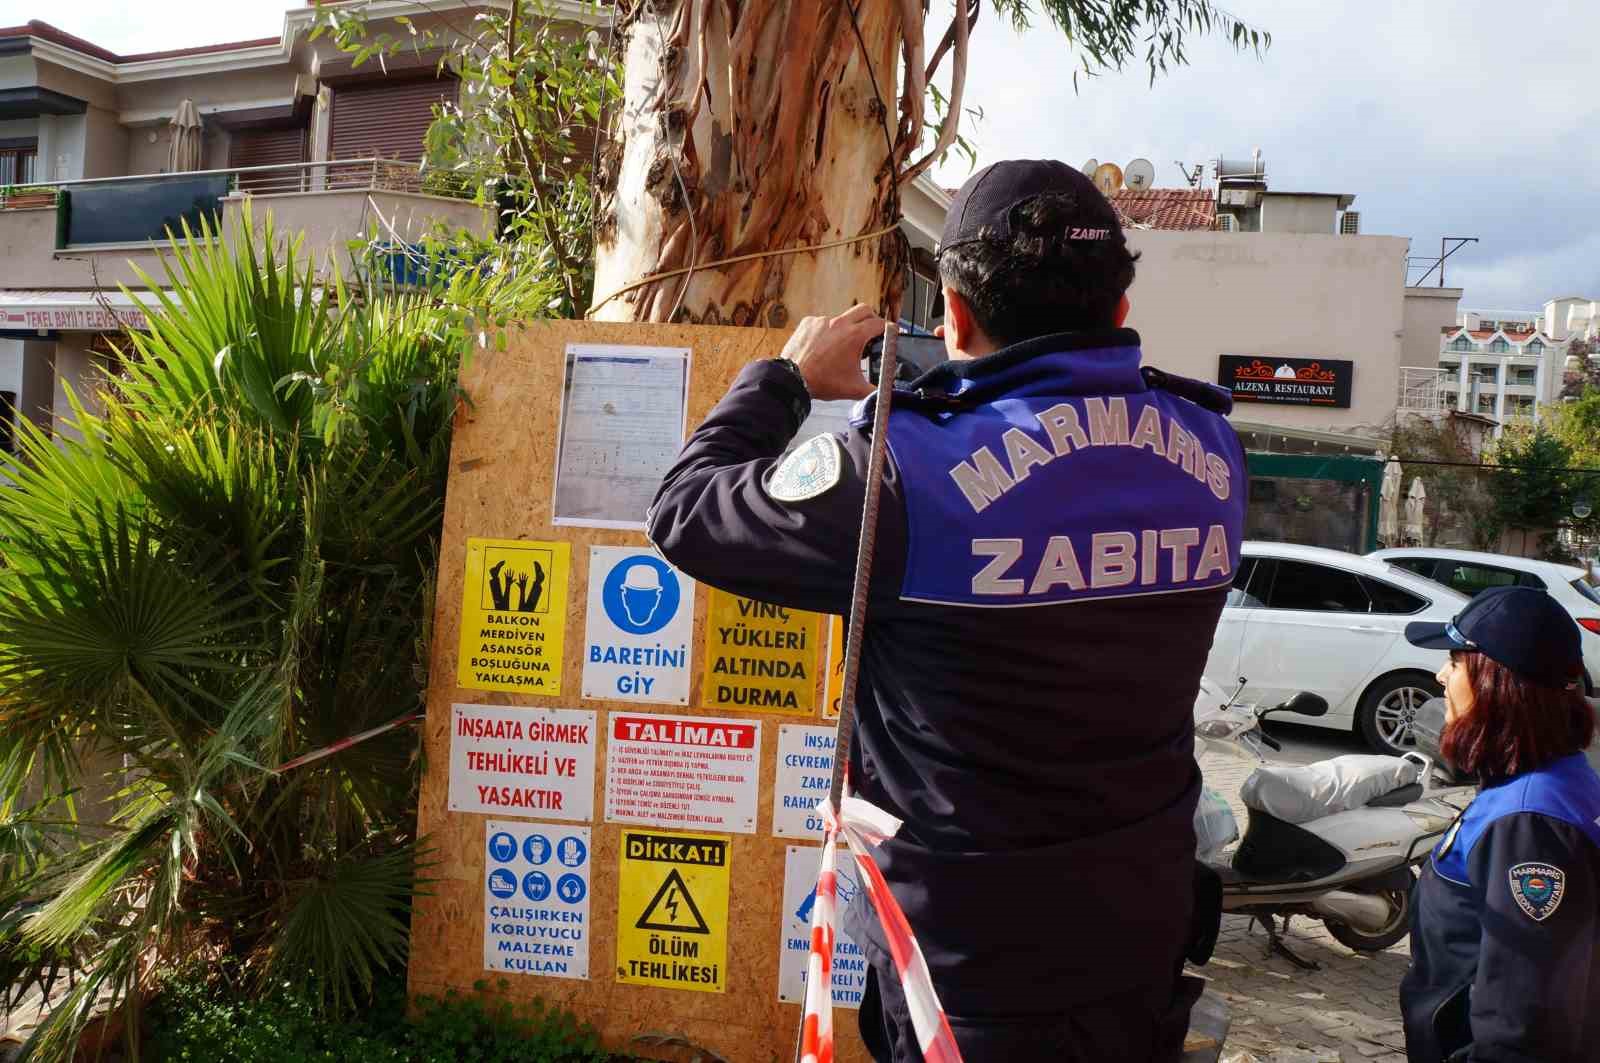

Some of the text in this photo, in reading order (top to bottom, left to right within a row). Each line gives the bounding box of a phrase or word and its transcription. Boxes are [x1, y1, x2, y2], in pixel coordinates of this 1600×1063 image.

[1234, 382, 1334, 395] ALZENA RESTAURANT
[949, 397, 1230, 513] MARMARIS
[971, 525, 1231, 595] ZABITA
[487, 615, 540, 626] BALKON
[480, 628, 545, 641] MERDİVEN
[718, 623, 806, 650] YÜKLERİ
[480, 643, 543, 656] ASANSÖR
[589, 643, 686, 668] BARETİNİ
[471, 657, 551, 673] BOŞLUĞUNA
[713, 657, 806, 679] ALTINDA
[475, 672, 545, 686] YAKLAŞMA
[617, 671, 655, 695] GİY
[717, 686, 798, 708] DURMA
[458, 711, 588, 744] İNŞAATA GİRMEK
[625, 721, 744, 746] TALİMAT
[467, 748, 576, 777] TEHLİKELİ VE
[785, 753, 834, 769] ÇEVREMİ
[801, 776, 831, 790] ZARA
[477, 785, 563, 810] YASAKTIR
[784, 795, 825, 809] RAHAT
[806, 815, 824, 831] ÖZ
[630, 837, 720, 863] DİKKAT!
[490, 906, 583, 924] ÇALIŞIRKEN
[491, 923, 582, 940] KORUYUCU
[498, 941, 574, 957] MALZEME
[649, 934, 698, 958] ÖLÜM
[504, 958, 567, 973] KULLAN
[628, 960, 718, 985] TEHLİKESİ
[832, 988, 861, 1003] AKTIR
